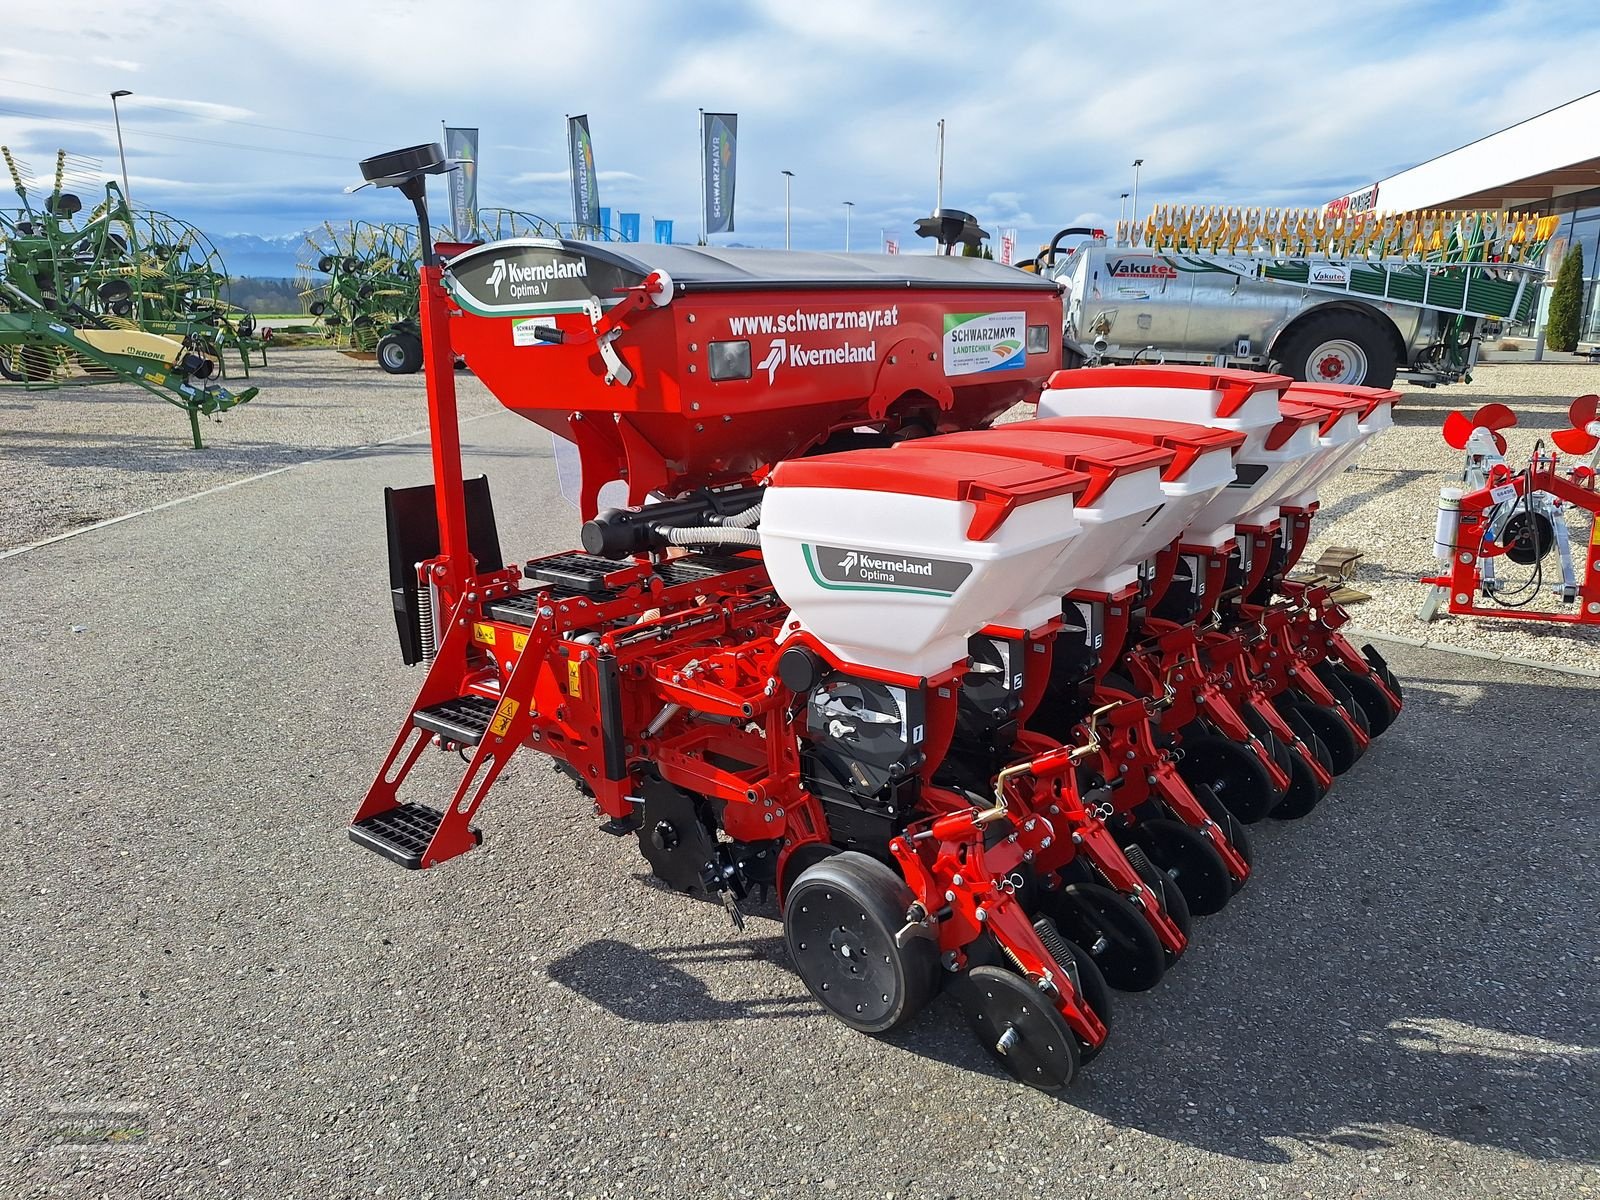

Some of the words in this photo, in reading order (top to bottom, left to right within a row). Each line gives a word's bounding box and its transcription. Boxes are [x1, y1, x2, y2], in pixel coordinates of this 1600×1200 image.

[577, 141, 589, 220] SCHWARZMAYR
[712, 137, 721, 218] SCHWARZMAYR
[508, 256, 588, 283] Kverneland
[1106, 260, 1177, 278] Vakutec
[1313, 271, 1346, 281] Vakutec
[510, 284, 540, 300] Optima
[541, 282, 548, 295] V
[729, 304, 898, 336] www.schwarzmayr.at
[952, 327, 1016, 342] SCHWARZMAYR
[135, 349, 166, 360] KRONE
[790, 341, 876, 368] Kverneland
[953, 344, 992, 355] LANDTECHNIK
[860, 554, 932, 576] Kverneland
[860, 568, 895, 582] Optima
